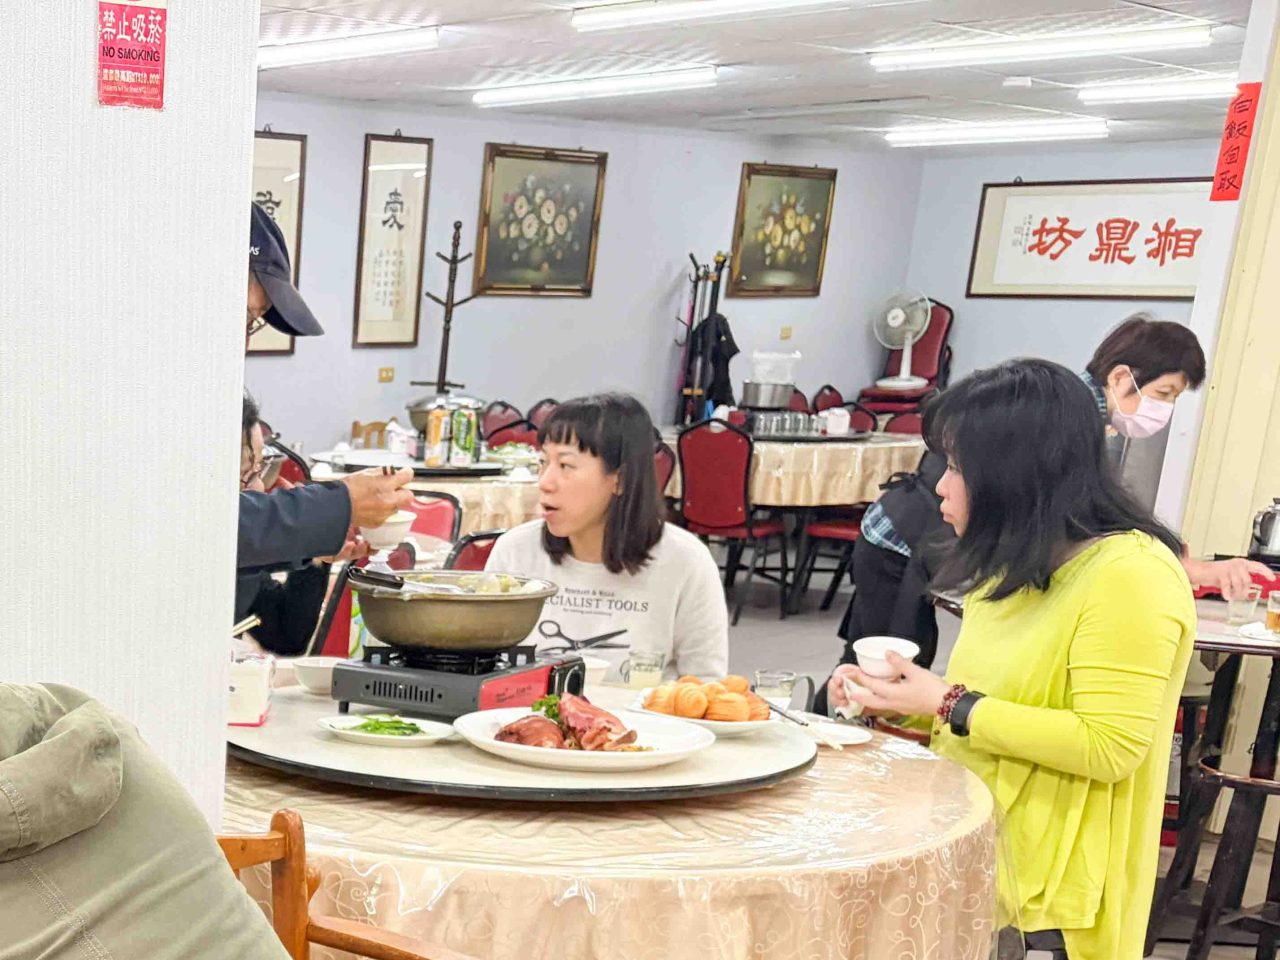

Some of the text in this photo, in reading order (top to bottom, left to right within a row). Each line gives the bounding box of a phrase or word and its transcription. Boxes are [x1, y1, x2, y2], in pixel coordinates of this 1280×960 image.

[102, 9, 163, 45] 禁止吸菸
[102, 45, 160, 62] NO SMOKING
[544, 595, 602, 609] ECIALIST
[606, 599, 649, 613] TOOLS
